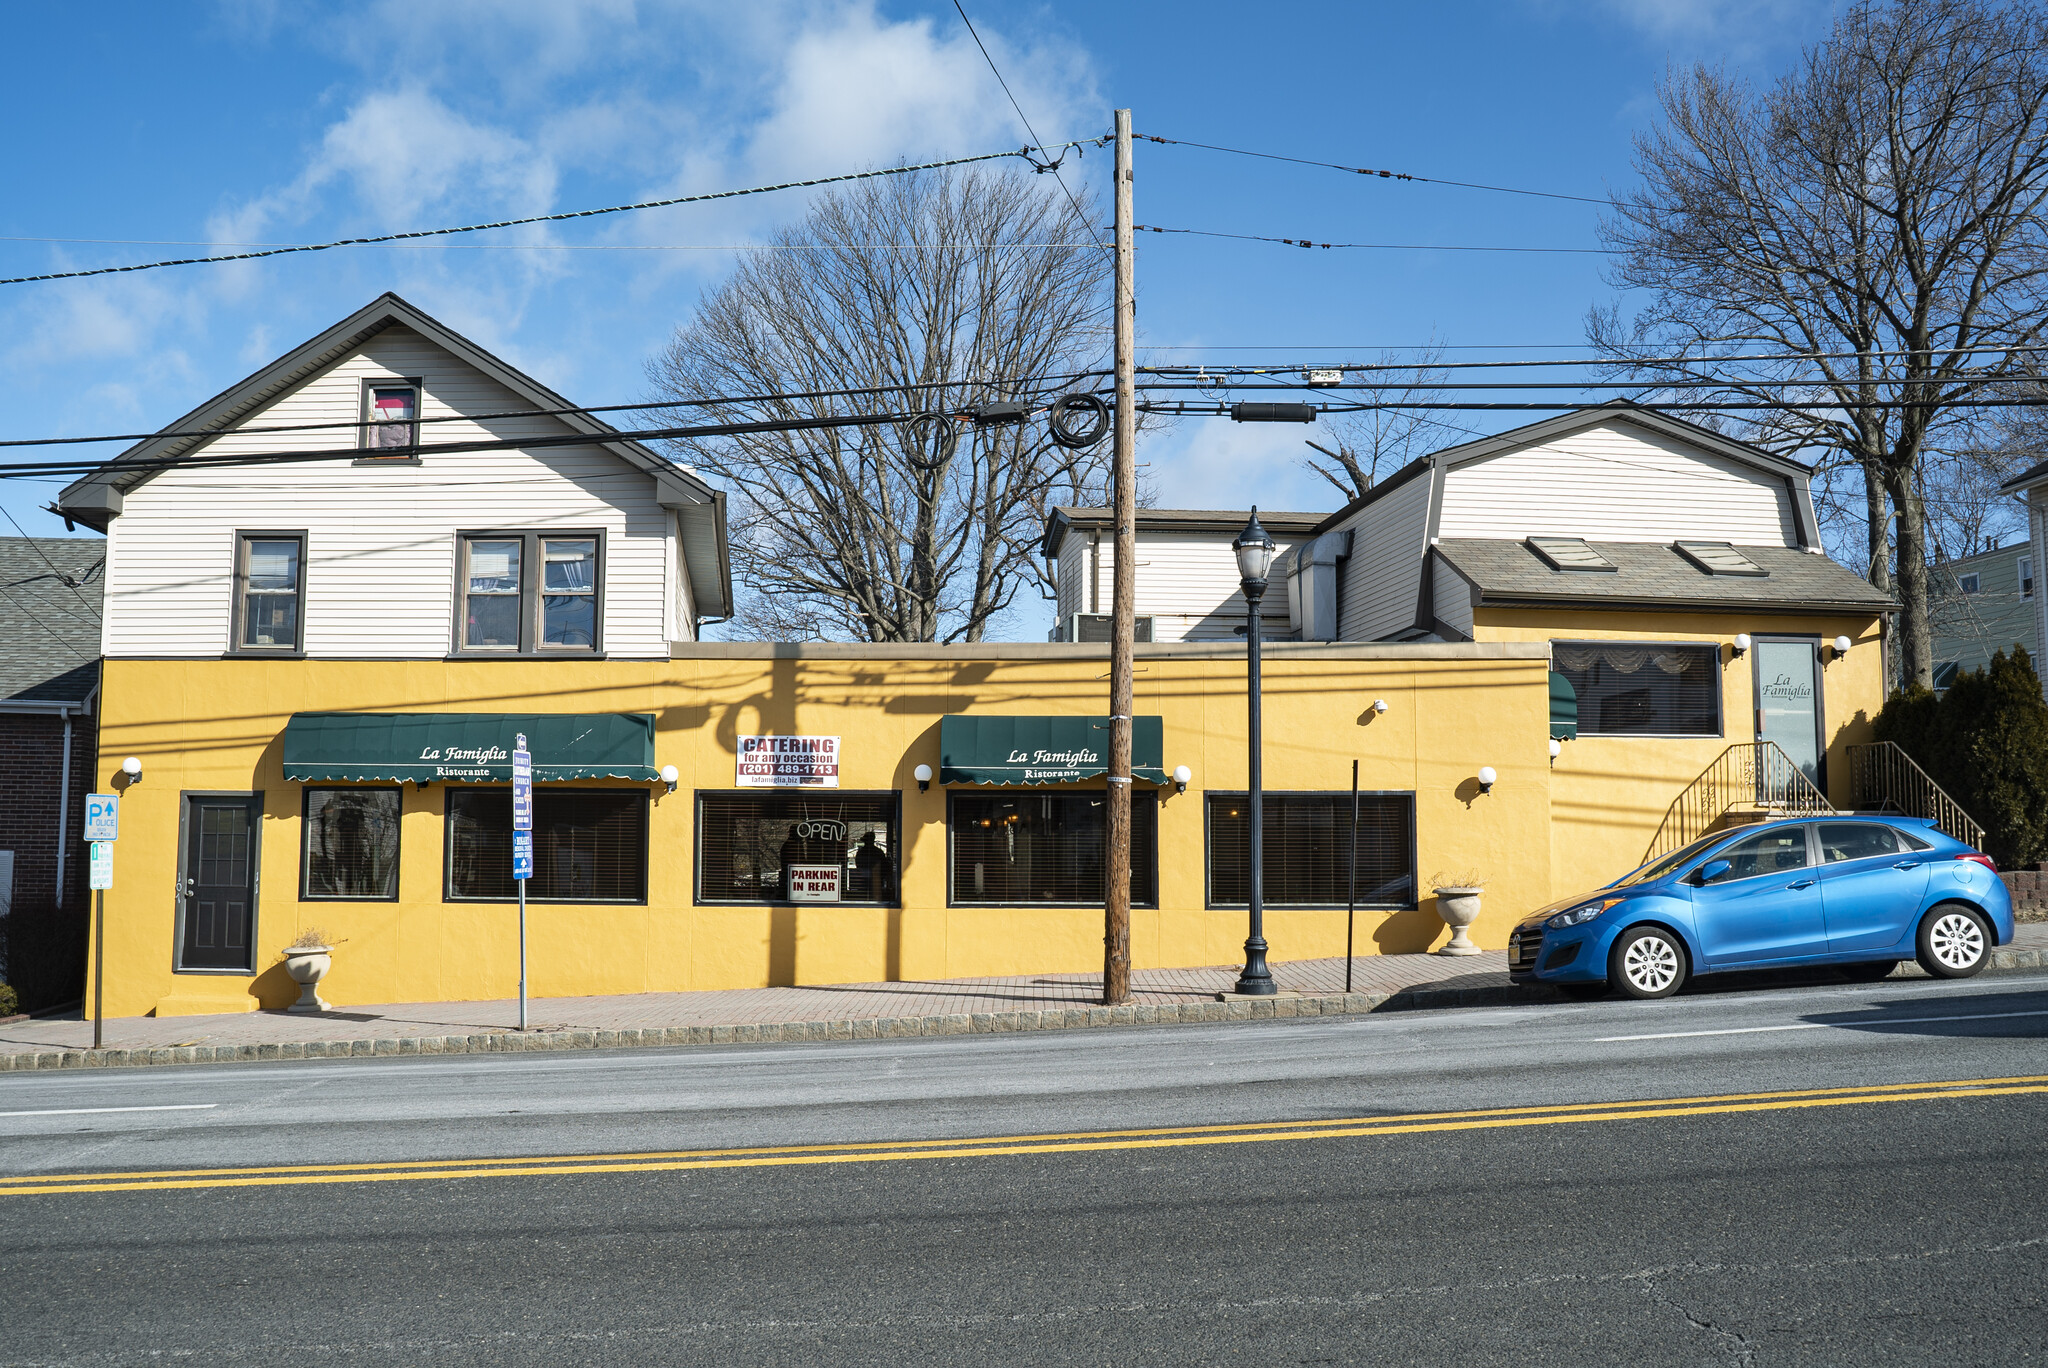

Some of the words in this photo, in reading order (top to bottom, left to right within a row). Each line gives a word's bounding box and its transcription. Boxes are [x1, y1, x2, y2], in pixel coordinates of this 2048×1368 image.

[1773, 673, 1790, 686] La
[1762, 682, 1811, 701] Famiglia
[743, 738, 834, 753] CATERING
[419, 746, 440, 760] La
[443, 745, 507, 765] Famiglia
[744, 753, 759, 763] for
[762, 754, 781, 764] any
[783, 753, 833, 763] occasion
[1006, 749, 1028, 763] La
[1032, 748, 1098, 768] Famiglia
[436, 766, 490, 776] Ristorante
[743, 764, 774, 775] (201)
[777, 764, 833, 774] 489-1713
[1024, 769, 1080, 779] Ristorante
[751, 776, 798, 784] lafamiglia.biz
[796, 821, 844, 841] OPEN
[791, 870, 838, 880] PARKING
[793, 881, 804, 892] IN
[808, 881, 835, 892] REAR
